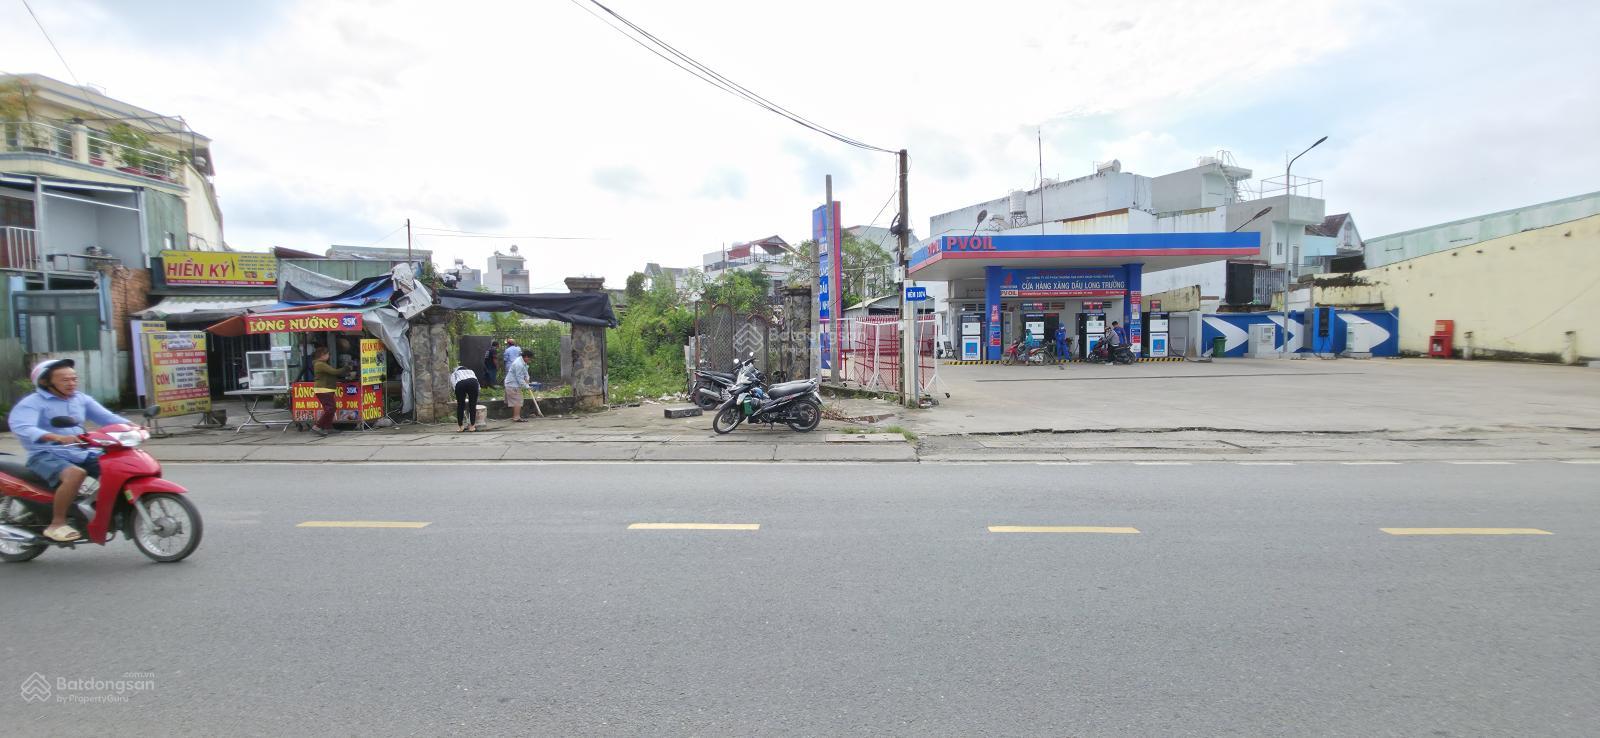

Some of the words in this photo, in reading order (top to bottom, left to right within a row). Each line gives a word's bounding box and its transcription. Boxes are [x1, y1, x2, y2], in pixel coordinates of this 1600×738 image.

[946, 236, 996, 250] PVOIL
[167, 258, 203, 276] HIỀN
[209, 261, 230, 277] KÝ
[1022, 280, 1034, 290] CỬA
[1036, 281, 1051, 290] HÀNG
[1054, 280, 1070, 290] XĂNG
[1072, 280, 1082, 289] DẦU
[1102, 279, 1124, 288] TRƯỜNG
[250, 318, 286, 332] LÒNG
[289, 316, 339, 330] NƯỚNG
[343, 318, 356, 326] 35K
[294, 384, 315, 398] LÒNG
